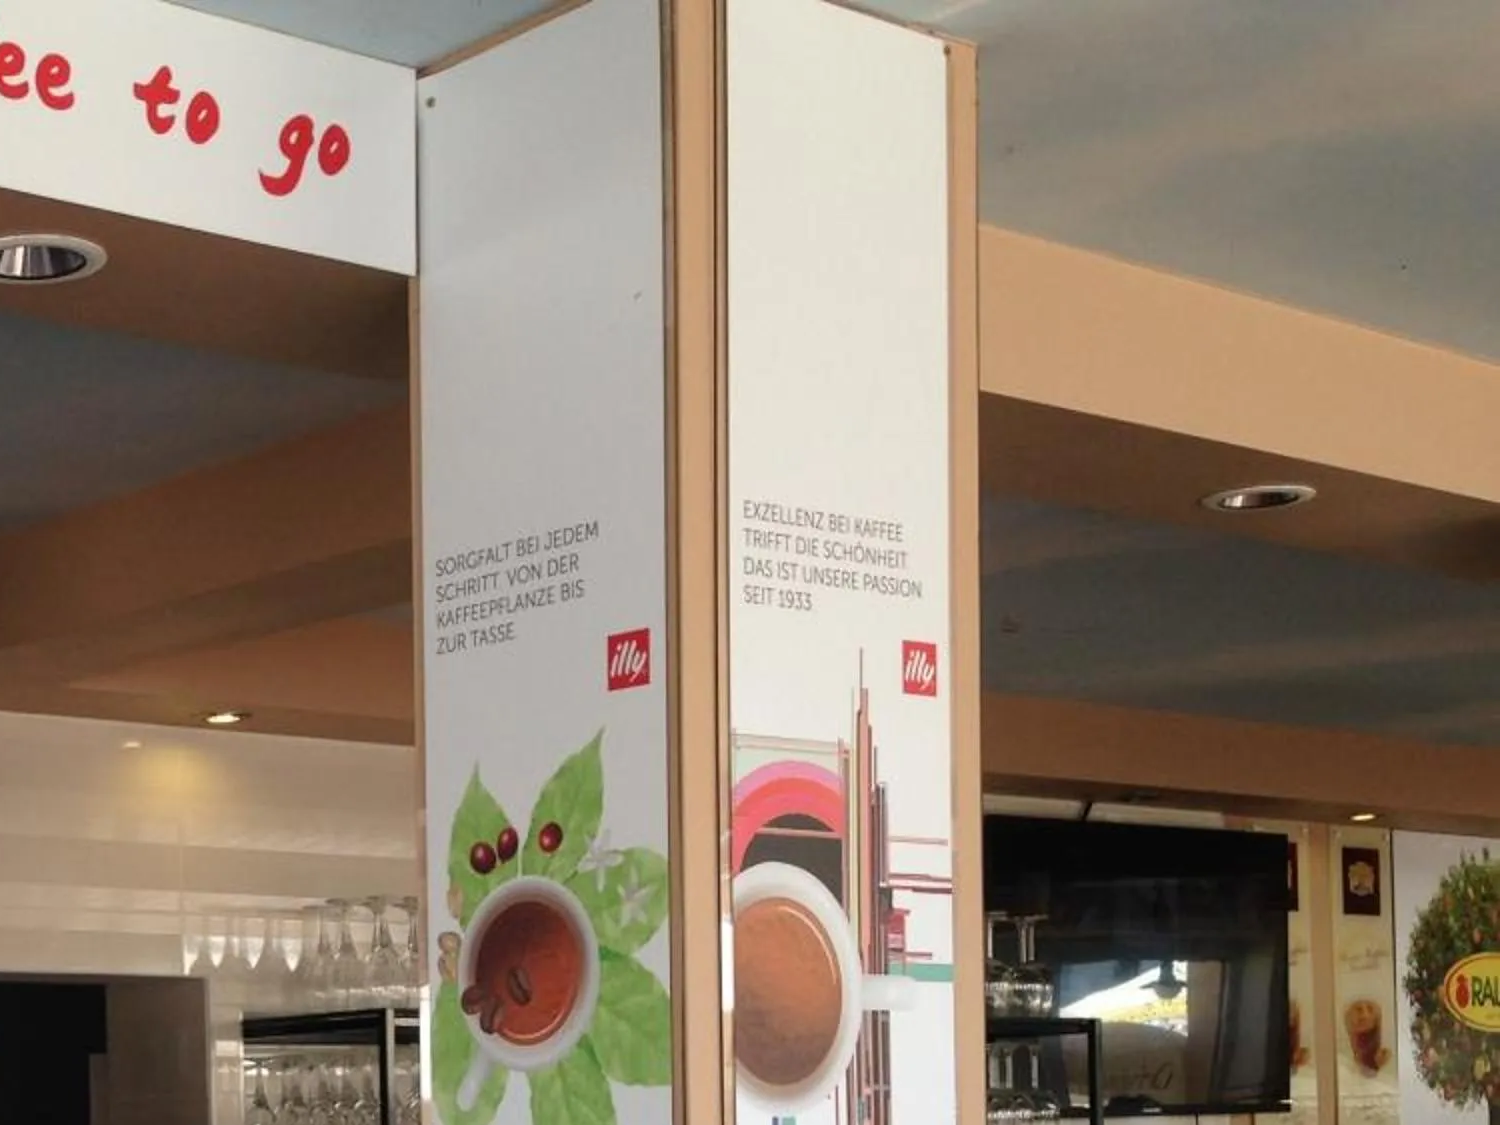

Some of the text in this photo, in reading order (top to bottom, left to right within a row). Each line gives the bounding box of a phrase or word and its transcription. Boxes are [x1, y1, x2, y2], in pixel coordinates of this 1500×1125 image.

[133, 66, 220, 144] to
[258, 114, 351, 196] go
[742, 527, 792, 552] TRIFFT
[796, 536, 819, 557] DIE
[743, 500, 904, 542] EXZELLENZ BEI KAFFEE
[435, 520, 599, 577] SORGFALT BEI JEDEM
[435, 552, 580, 603] SCHRITT VON DER
[743, 556, 923, 598] DAS IST UNSERE PASSION
[743, 584, 813, 612] SEIT 1933
[436, 579, 586, 629] KAFFEEPFLANZE BIS
[436, 621, 516, 655] ZUR TASSE
[611, 639, 647, 683] illy
[905, 650, 934, 690] illy
